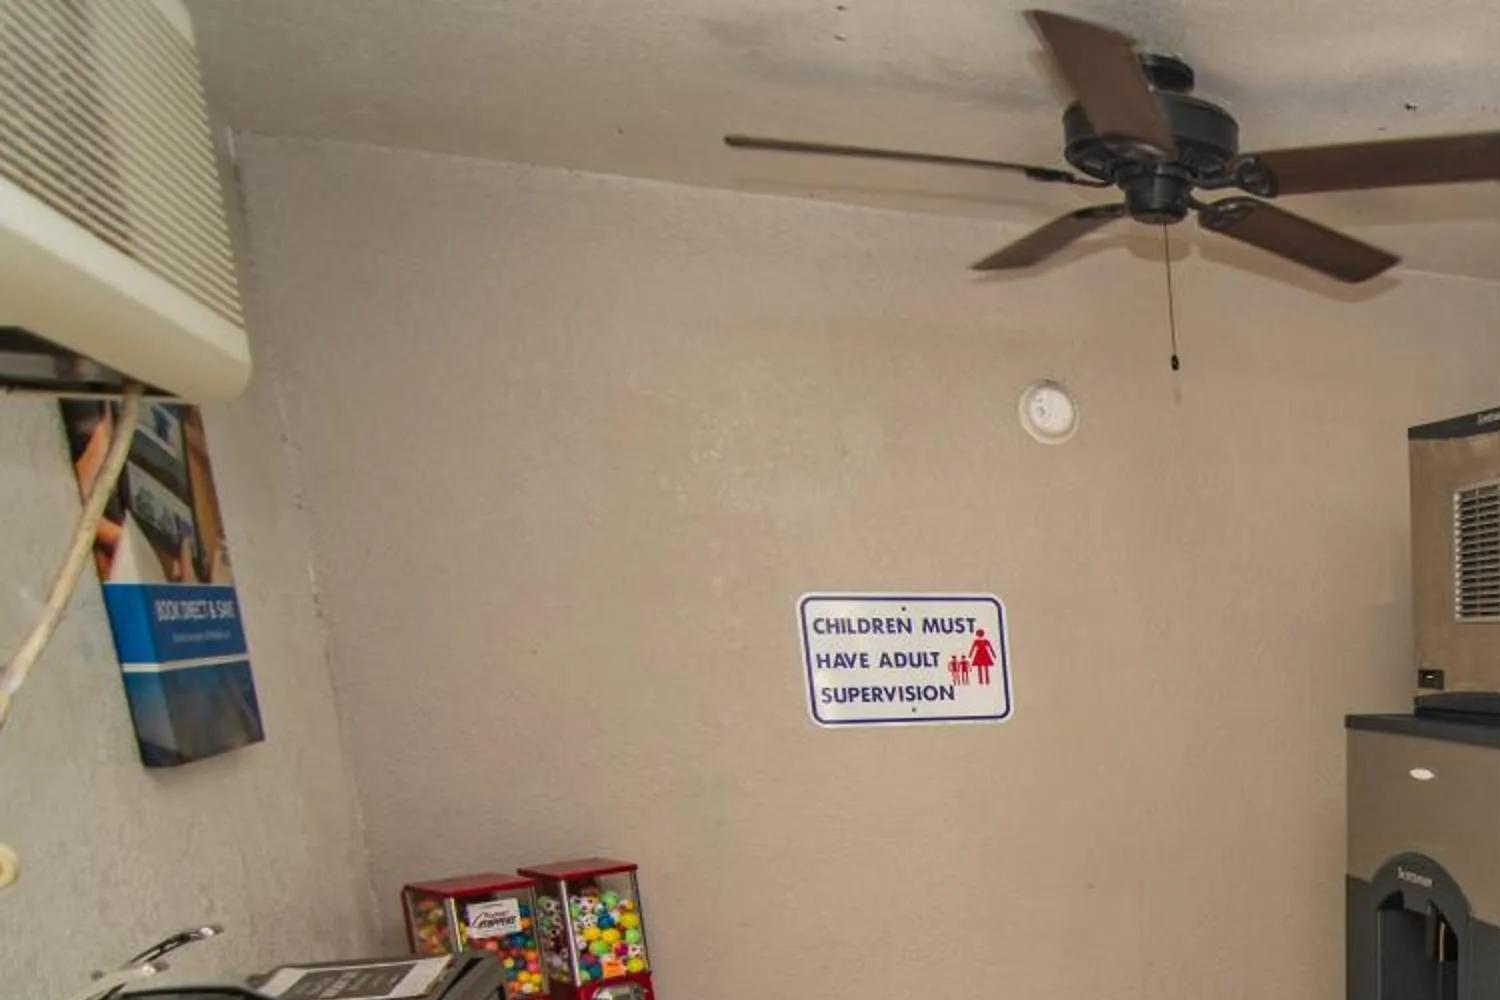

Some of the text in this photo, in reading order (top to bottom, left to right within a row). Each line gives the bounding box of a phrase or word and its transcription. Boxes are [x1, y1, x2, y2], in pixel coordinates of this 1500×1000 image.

[813, 616, 978, 635] CHILDREN MUST
[816, 651, 941, 669] HAVE ADULT
[821, 685, 956, 704] SUPERVISION
